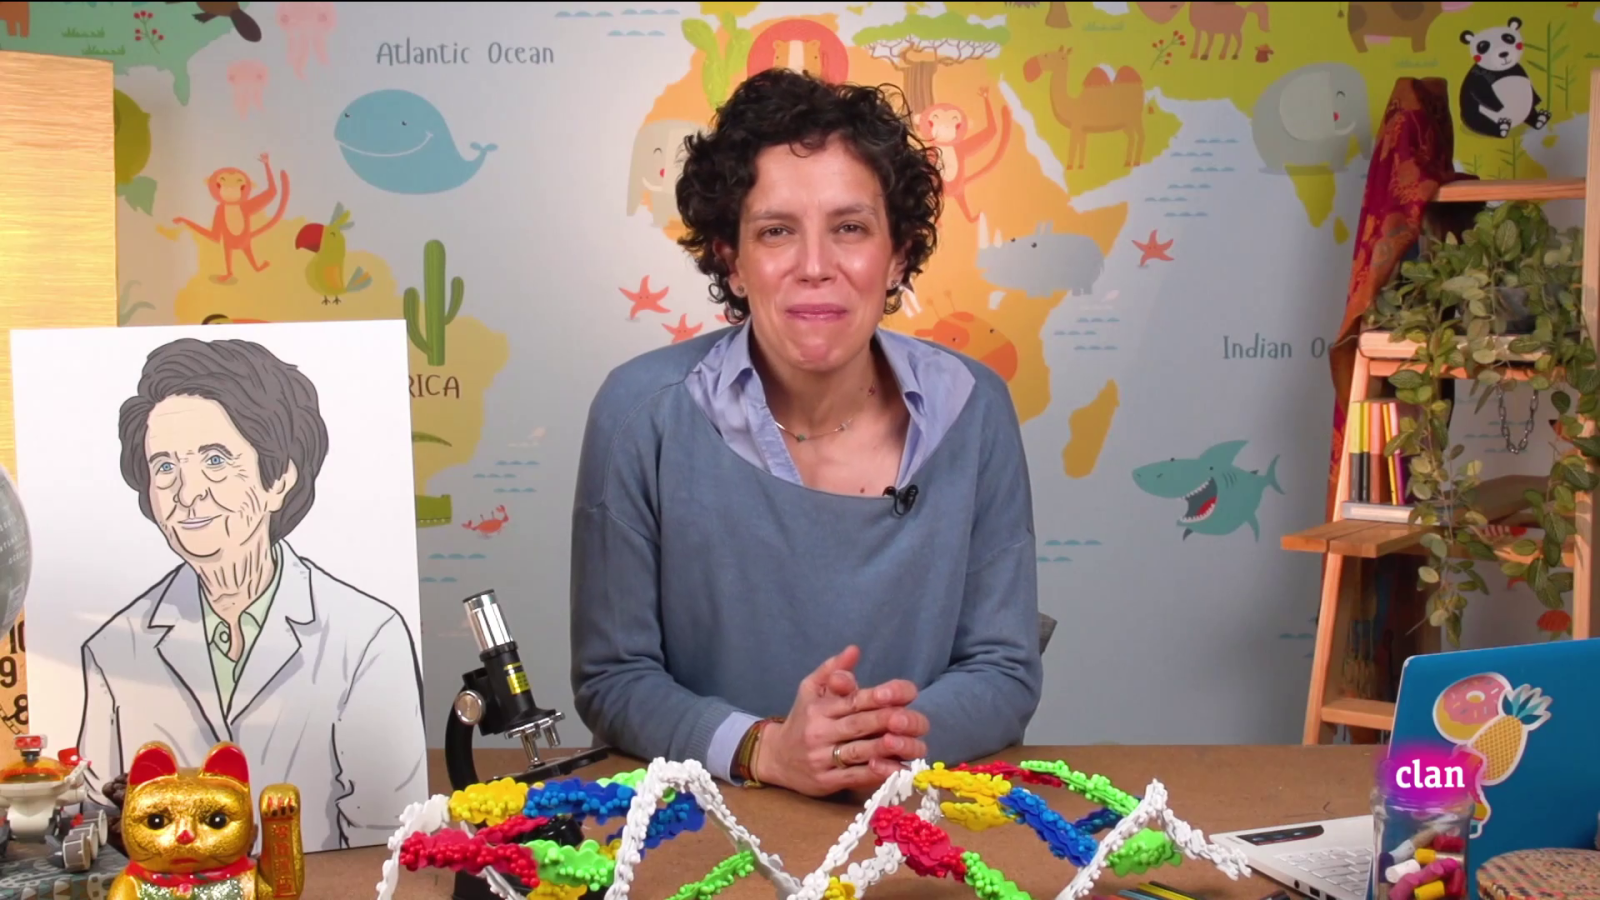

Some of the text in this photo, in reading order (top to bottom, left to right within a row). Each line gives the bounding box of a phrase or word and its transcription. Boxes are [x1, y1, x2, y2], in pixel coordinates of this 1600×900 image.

[376, 37, 555, 66] Atlantic Ocean
[1223, 333, 1292, 359] Indian
[0, 655, 17, 688] 9
[14, 694, 29, 725] 8
